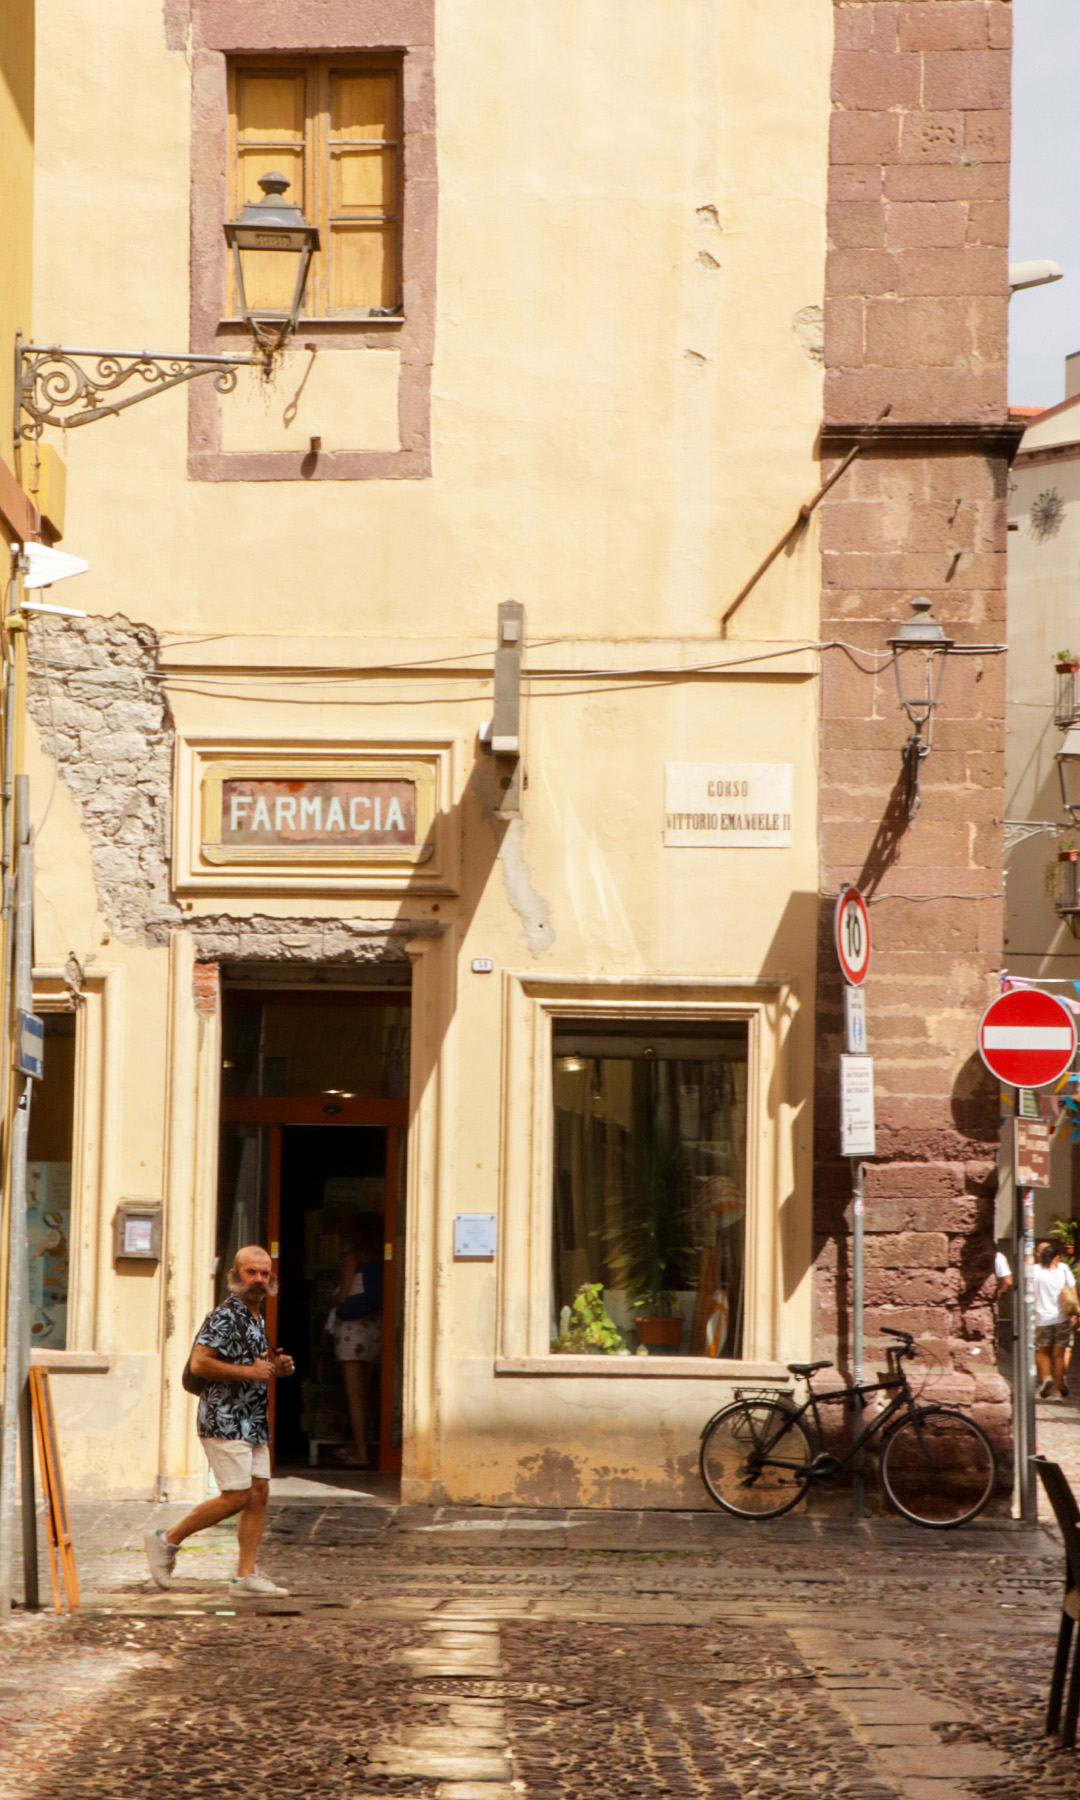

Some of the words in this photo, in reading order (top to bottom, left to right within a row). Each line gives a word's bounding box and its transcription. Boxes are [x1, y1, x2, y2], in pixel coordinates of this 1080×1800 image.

[707, 781, 748, 797] CORSO
[230, 796, 406, 831] FARMACIA
[666, 813, 718, 830] VITTORIO
[720, 813, 779, 830] EMANUELE
[783, 814, 791, 830] II
[846, 913, 861, 958] 10
